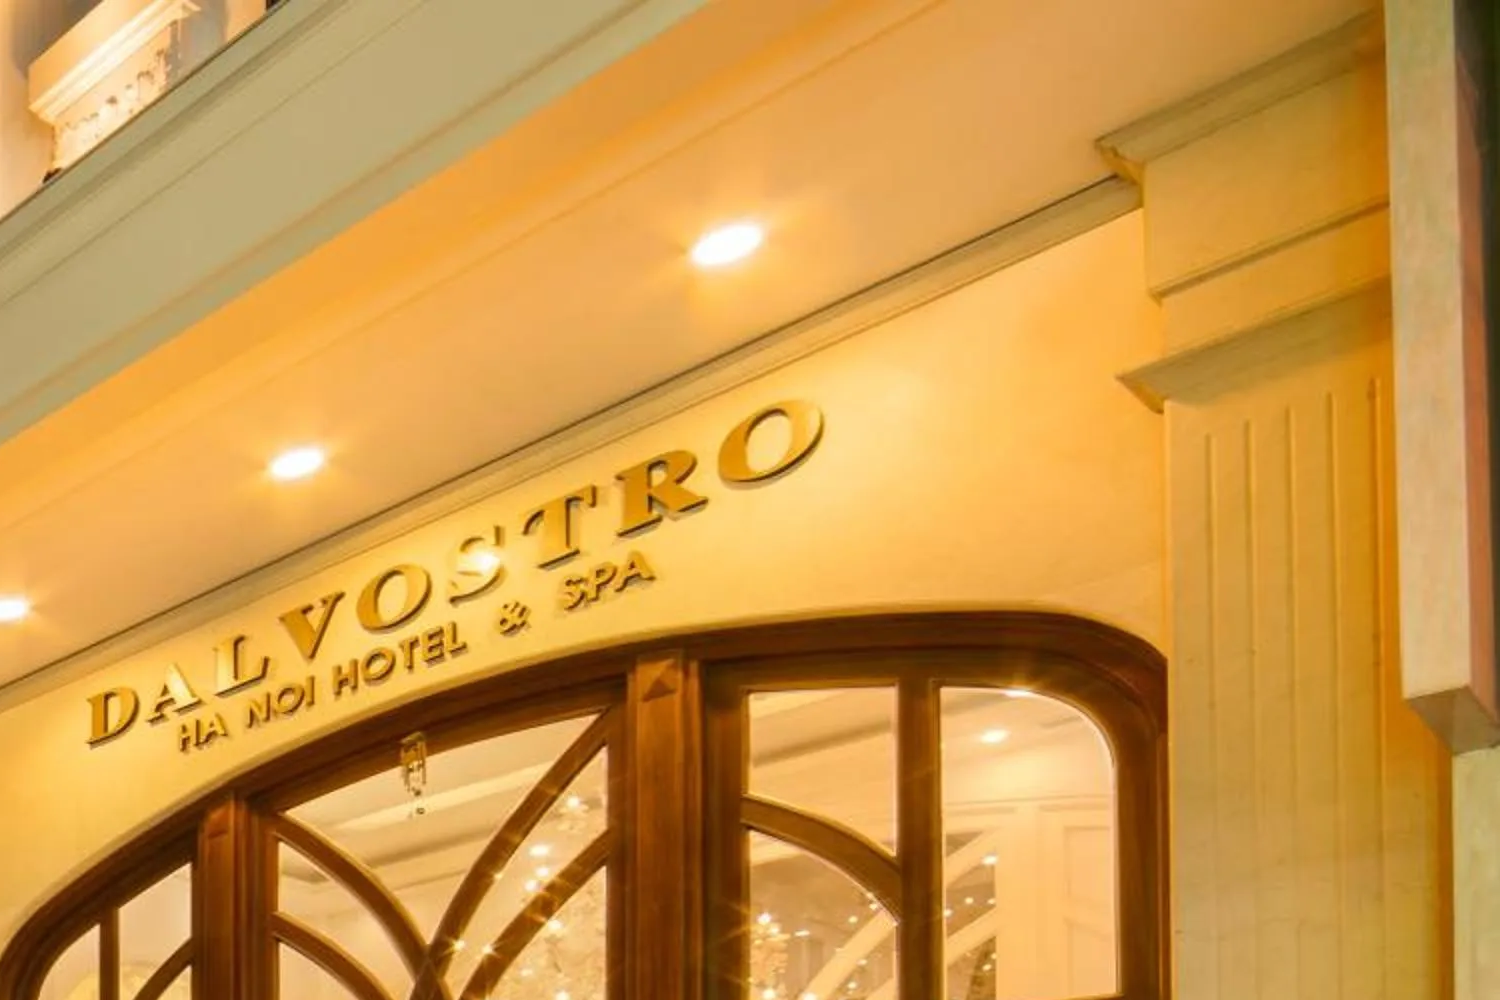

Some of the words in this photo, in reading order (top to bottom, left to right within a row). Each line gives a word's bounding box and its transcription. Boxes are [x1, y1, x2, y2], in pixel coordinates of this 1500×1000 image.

[179, 711, 230, 753] HA
[246, 674, 317, 728] NOI
[334, 621, 467, 697] HOTEL
[498, 601, 532, 637] &
[559, 551, 657, 612] SPA
